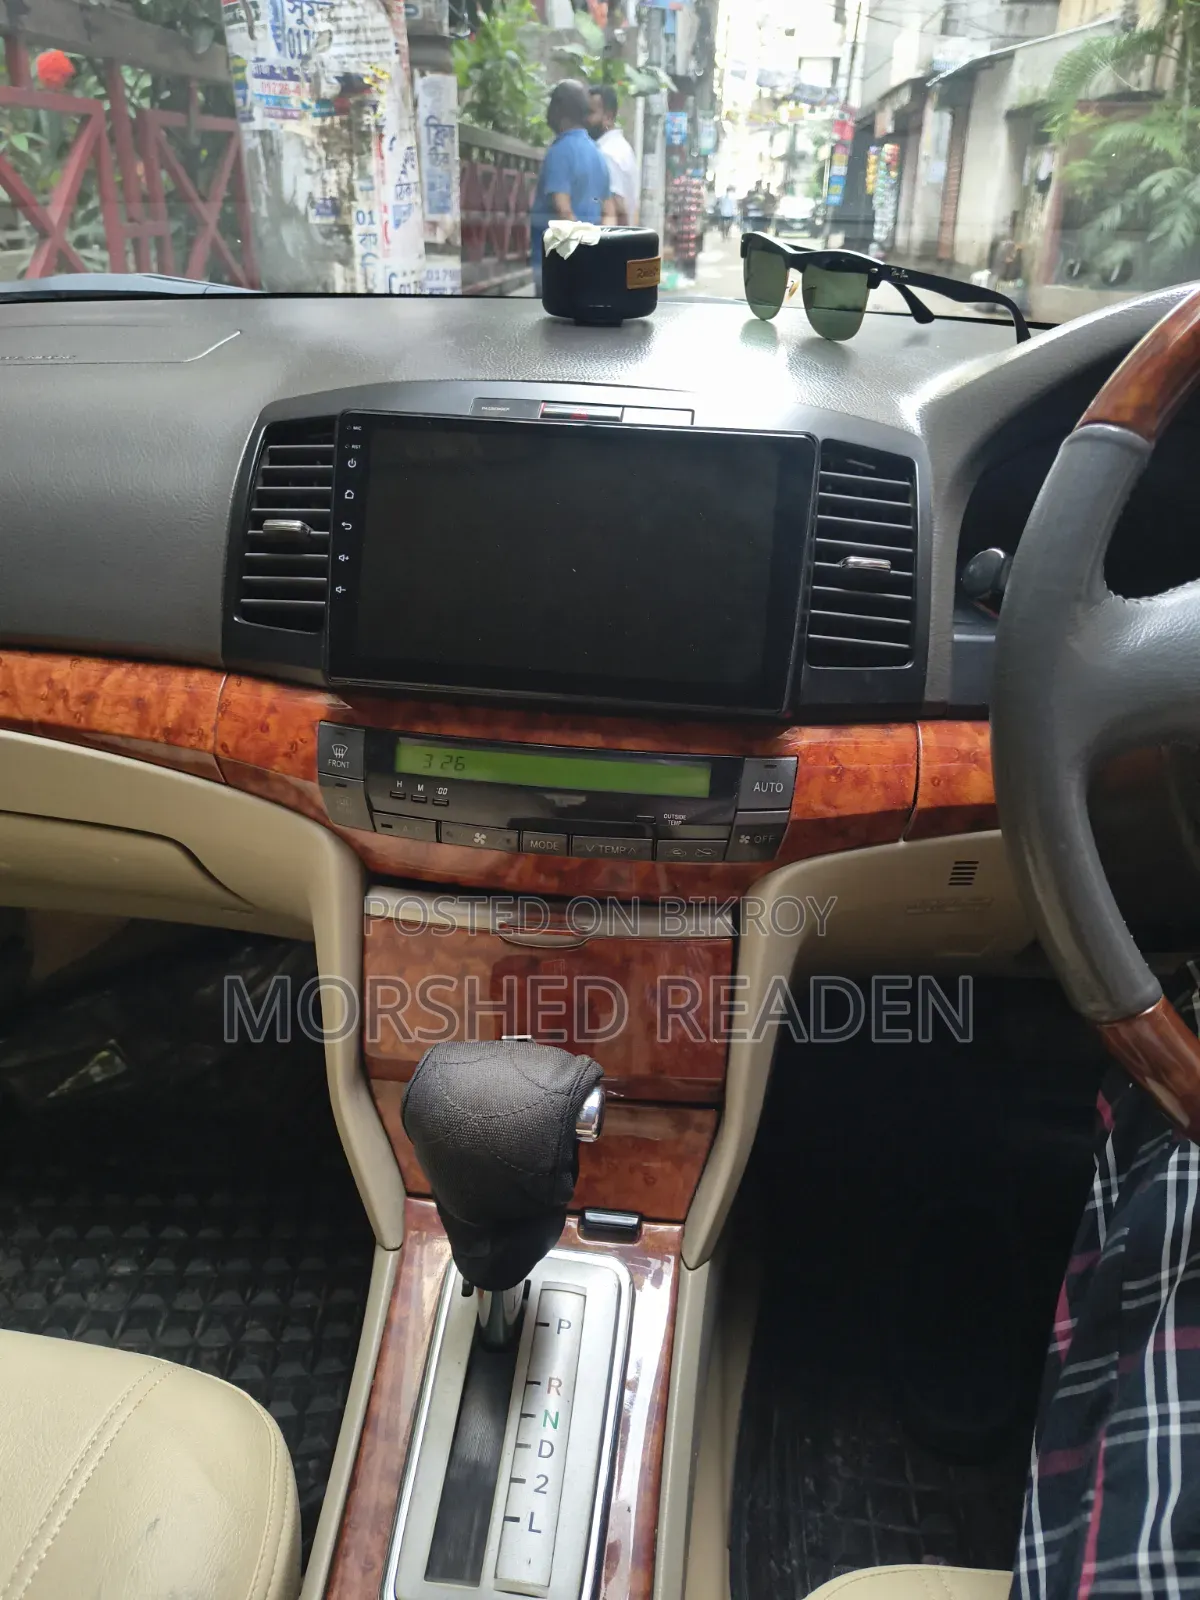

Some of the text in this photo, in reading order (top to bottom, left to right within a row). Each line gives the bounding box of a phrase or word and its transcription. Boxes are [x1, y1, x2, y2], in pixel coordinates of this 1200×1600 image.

[327, 759, 350, 769] FRONT
[396, 780, 403, 788] H
[417, 783, 424, 792] M
[753, 781, 784, 794] AUTO
[663, 813, 687, 821] OUTSIDE
[530, 839, 559, 851] MODE
[753, 835, 774, 845] OFF
[599, 844, 626, 855] TEMP
[556, 1318, 572, 1335] P
[546, 1376, 563, 1396] R
[542, 1409, 560, 1430] N
[537, 1439, 555, 1459] D
[533, 1474, 549, 1495] 2
[528, 1511, 542, 1534] L
